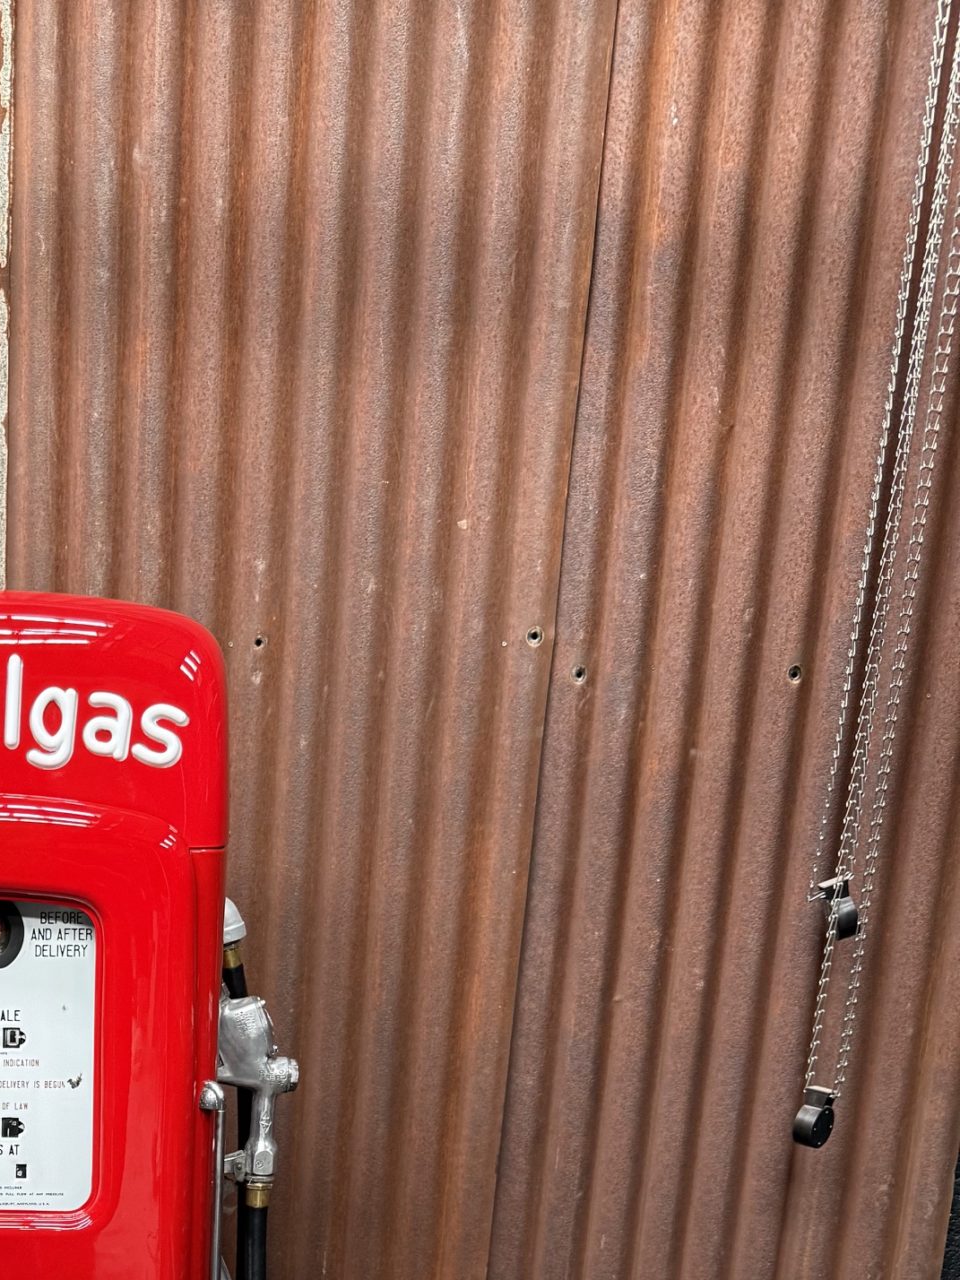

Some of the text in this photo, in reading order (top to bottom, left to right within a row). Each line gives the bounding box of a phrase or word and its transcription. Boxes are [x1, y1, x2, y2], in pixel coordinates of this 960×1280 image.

[39, 911, 83, 925] BEFORE
[31, 928, 93, 941] AND AFTER
[34, 944, 88, 958] DELIVERY
[3, 1058, 40, 1067] INDICATION
[33, 1079, 41, 1088] IS
[1, 1101, 11, 1110] OF
[14, 1101, 29, 1110] LAW
[8, 1143, 21, 1156] AT
